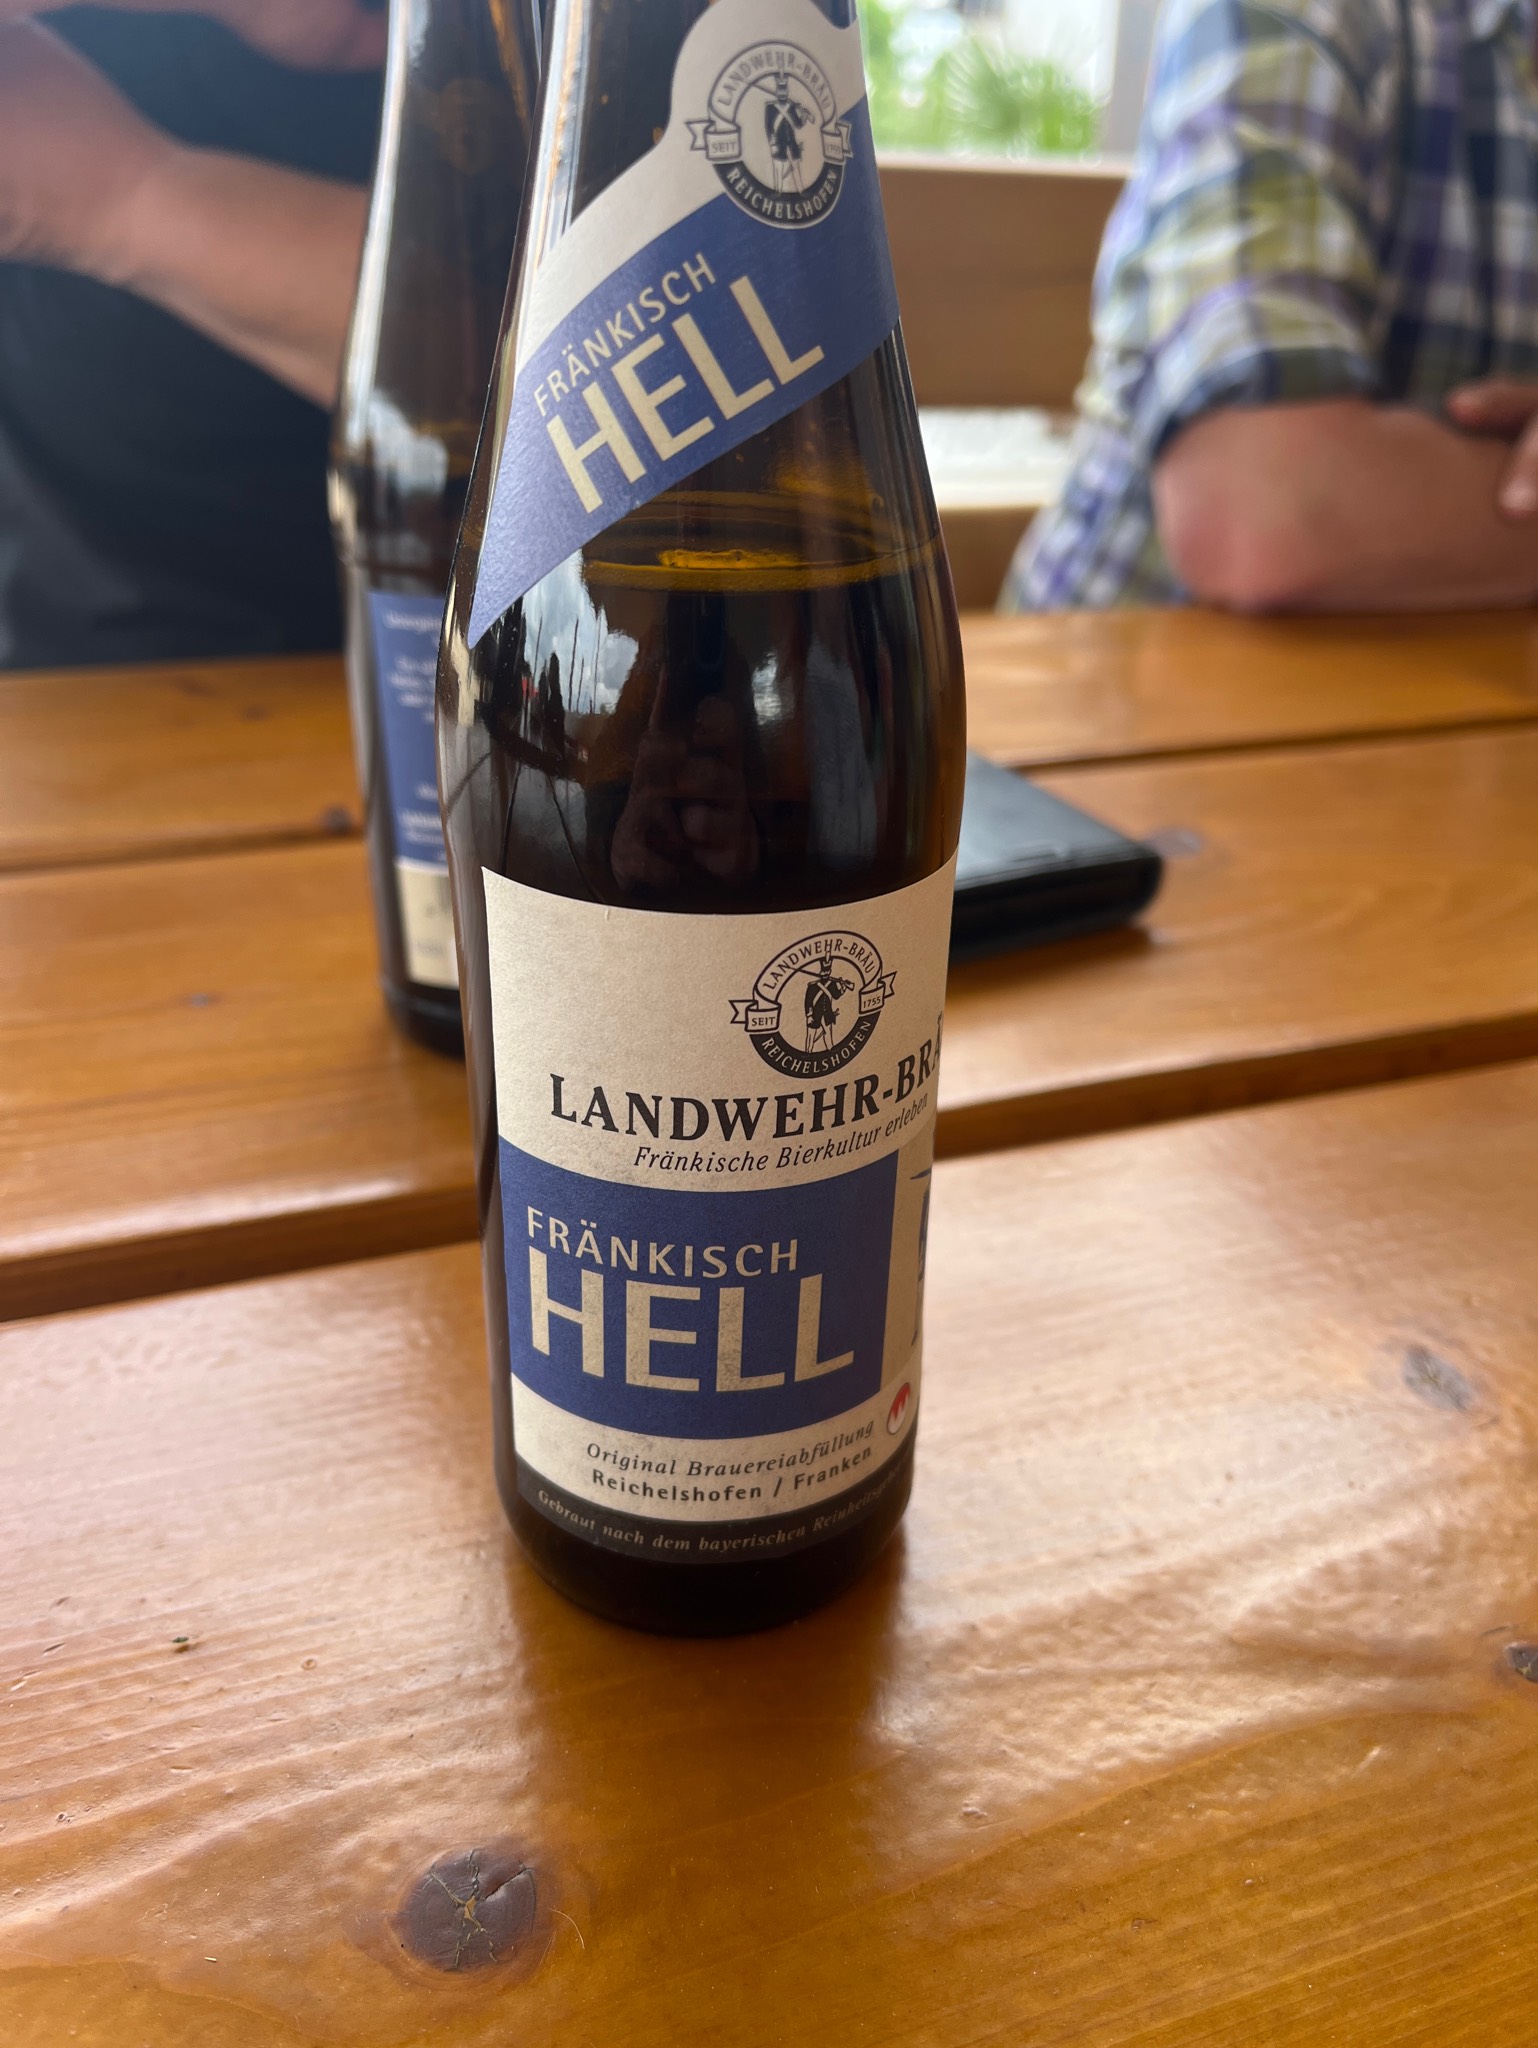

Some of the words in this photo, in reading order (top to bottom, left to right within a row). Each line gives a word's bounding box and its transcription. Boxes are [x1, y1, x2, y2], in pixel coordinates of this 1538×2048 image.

[726, 168, 838, 220] REICHELSHOFEN
[533, 251, 716, 417] FRÄNKISCH
[546, 276, 825, 515] HELL
[763, 938, 876, 990] LANDWEHR-BRÄU
[751, 1016, 776, 1026] SEIT
[863, 997, 881, 1009] 1755
[550, 1010, 943, 1141] LANDWEHR-BRÄ
[762, 1020, 871, 1074] REICHELSHOFEN
[633, 1146, 769, 1173] Fränkische
[776, 1125, 881, 1170] Bierkultur
[885, 1091, 928, 1137] erleben
[527, 1205, 798, 1278] FRÄNKISCH
[529, 1245, 855, 1393] HELL
[587, 1443, 677, 1475] Original
[687, 1419, 875, 1477] Brauereiabfüllung
[592, 1468, 762, 1502] Reichelshofen
[773, 1477, 783, 1498] /
[793, 1447, 871, 1490] Franken
[537, 1490, 596, 1531] Gebraut
[602, 1525, 645, 1545] nach
[652, 1534, 690, 1550] dem
[699, 1526, 805, 1553] bayerischen
